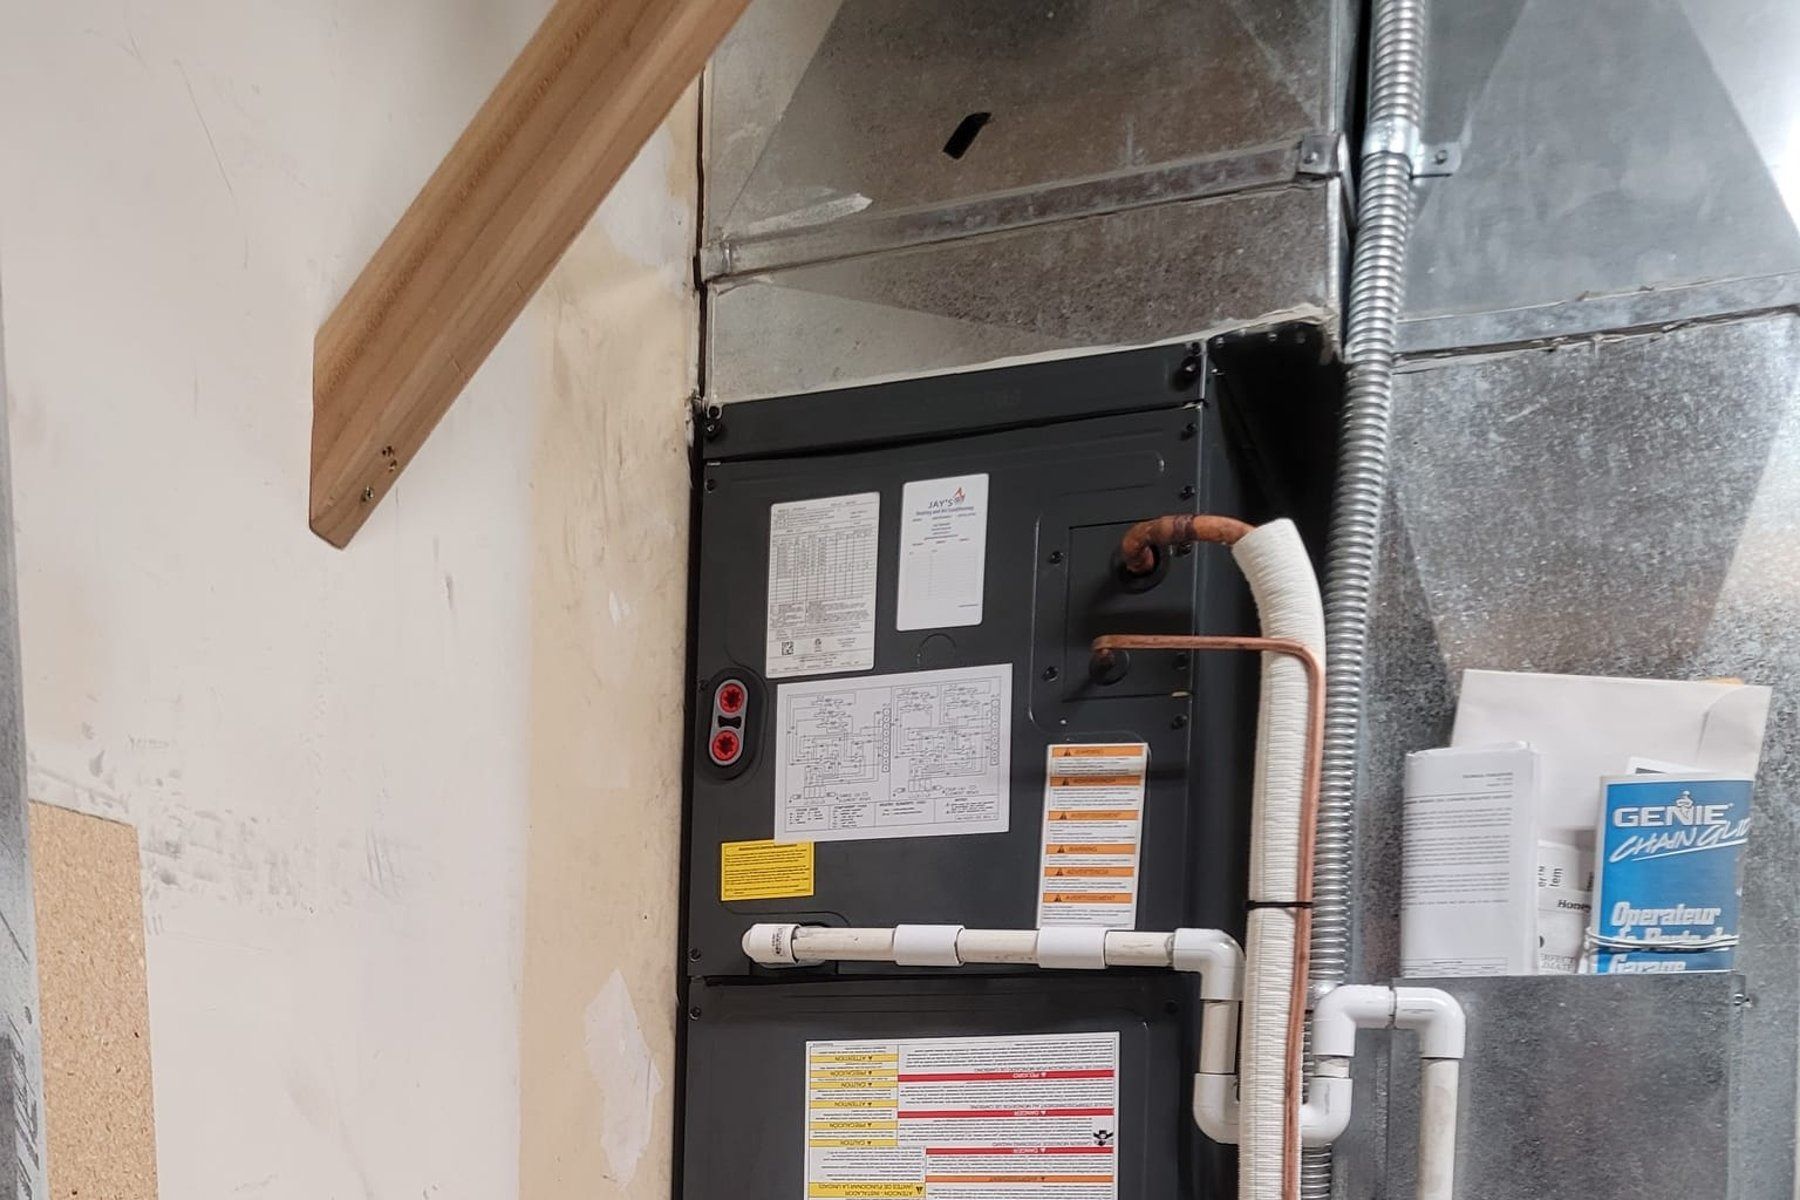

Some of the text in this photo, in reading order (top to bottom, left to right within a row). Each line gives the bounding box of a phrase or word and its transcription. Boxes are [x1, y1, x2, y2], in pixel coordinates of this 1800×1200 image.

[928, 498, 953, 509] JAY'S
[1613, 805, 1729, 827] GENIE
[1609, 827, 1697, 863] CHAIN
